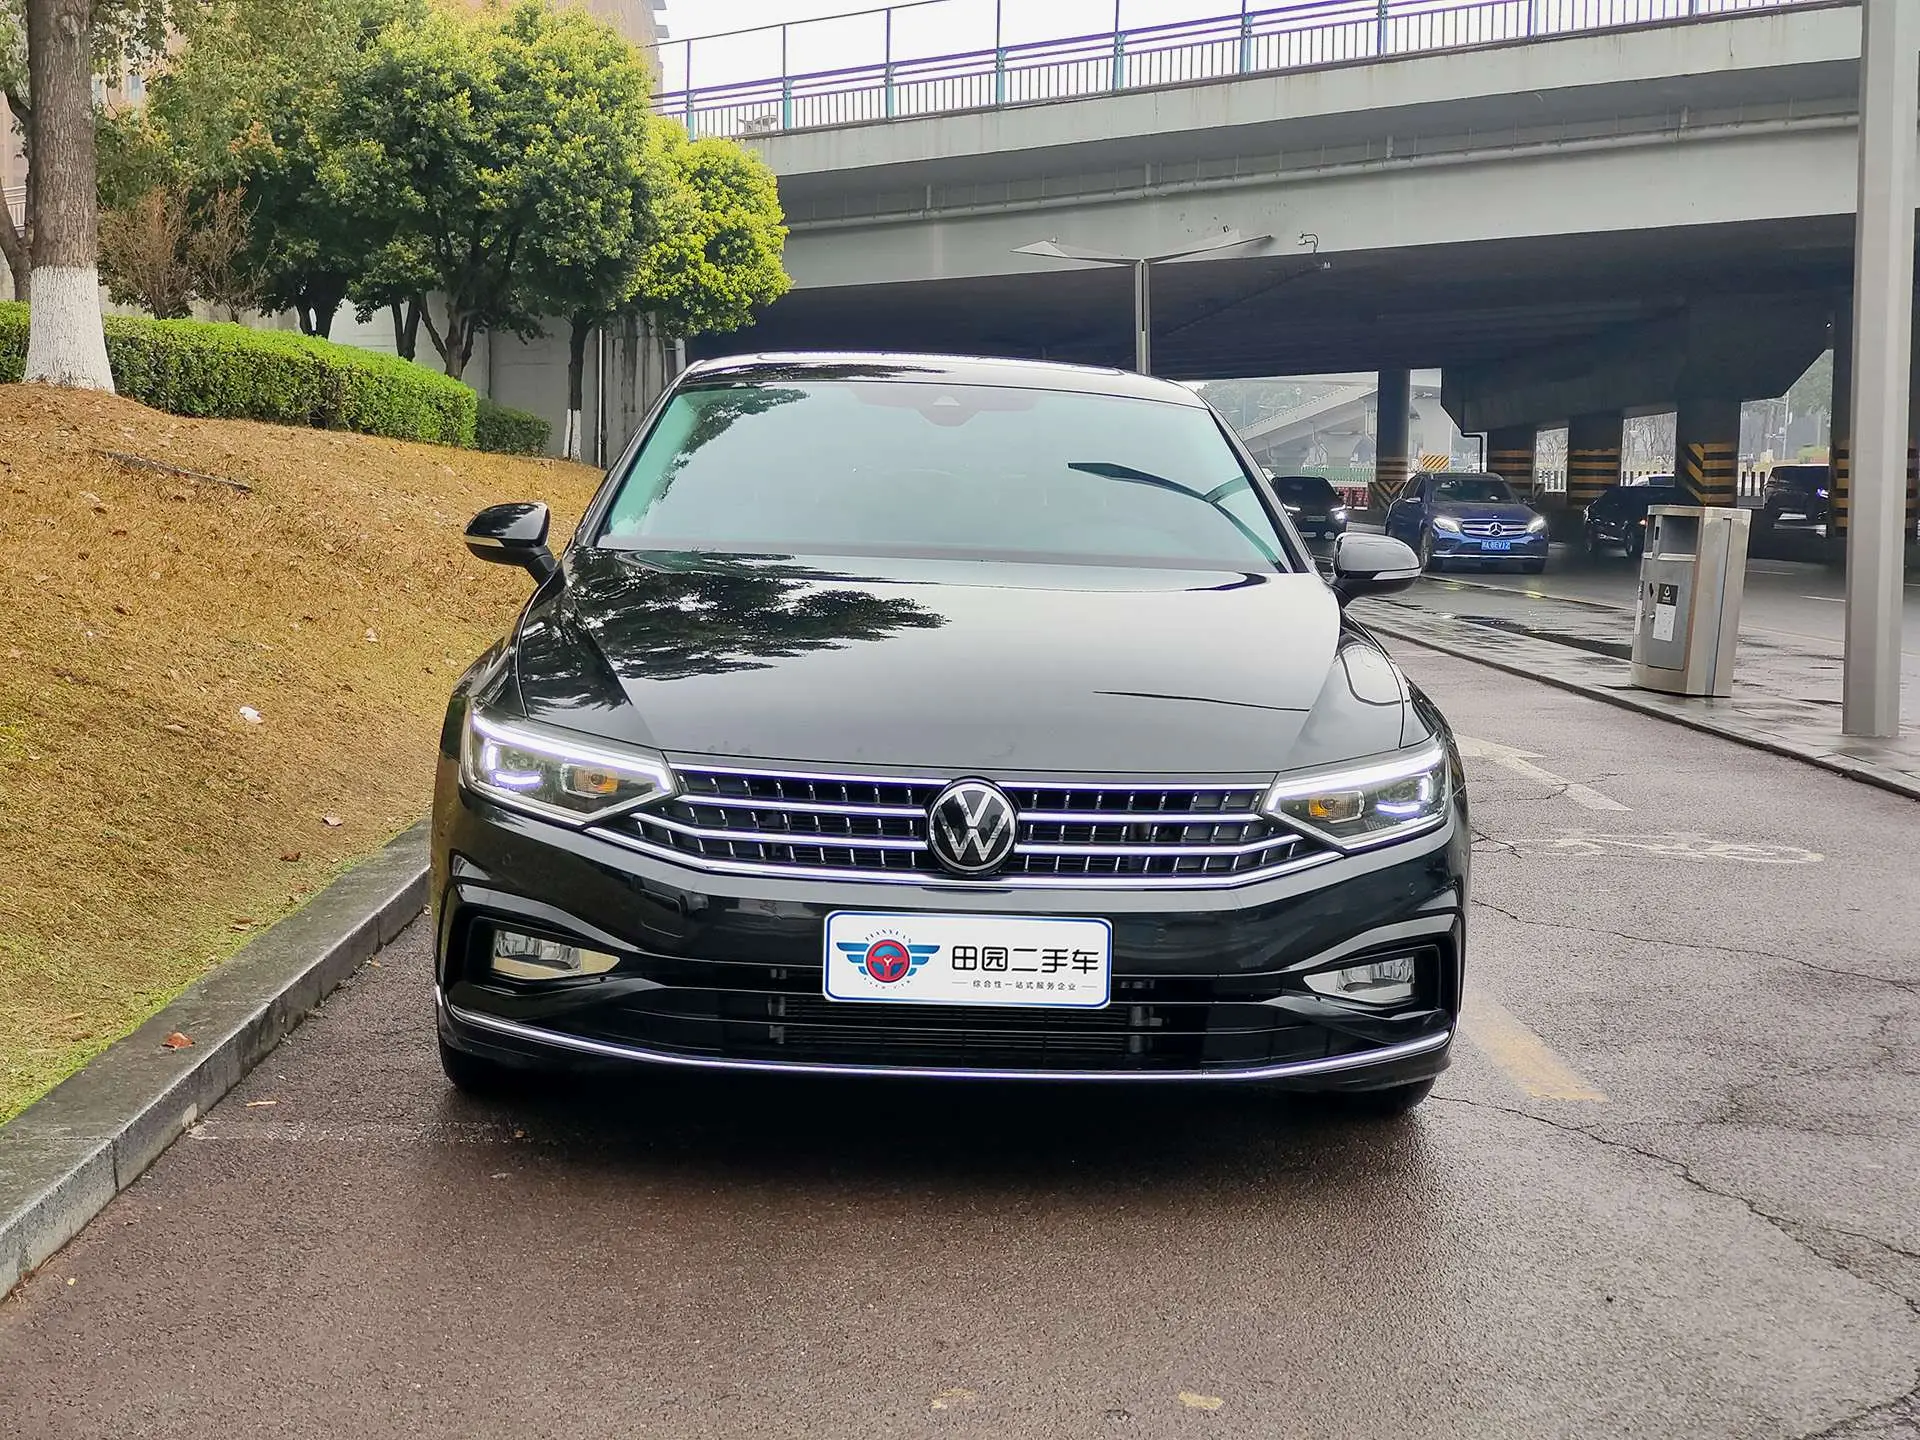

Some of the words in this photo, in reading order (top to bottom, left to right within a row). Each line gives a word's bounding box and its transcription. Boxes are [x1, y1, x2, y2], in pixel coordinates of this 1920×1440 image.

[931, 784, 1014, 868] VW
[952, 946, 1099, 974] 田园二手车
